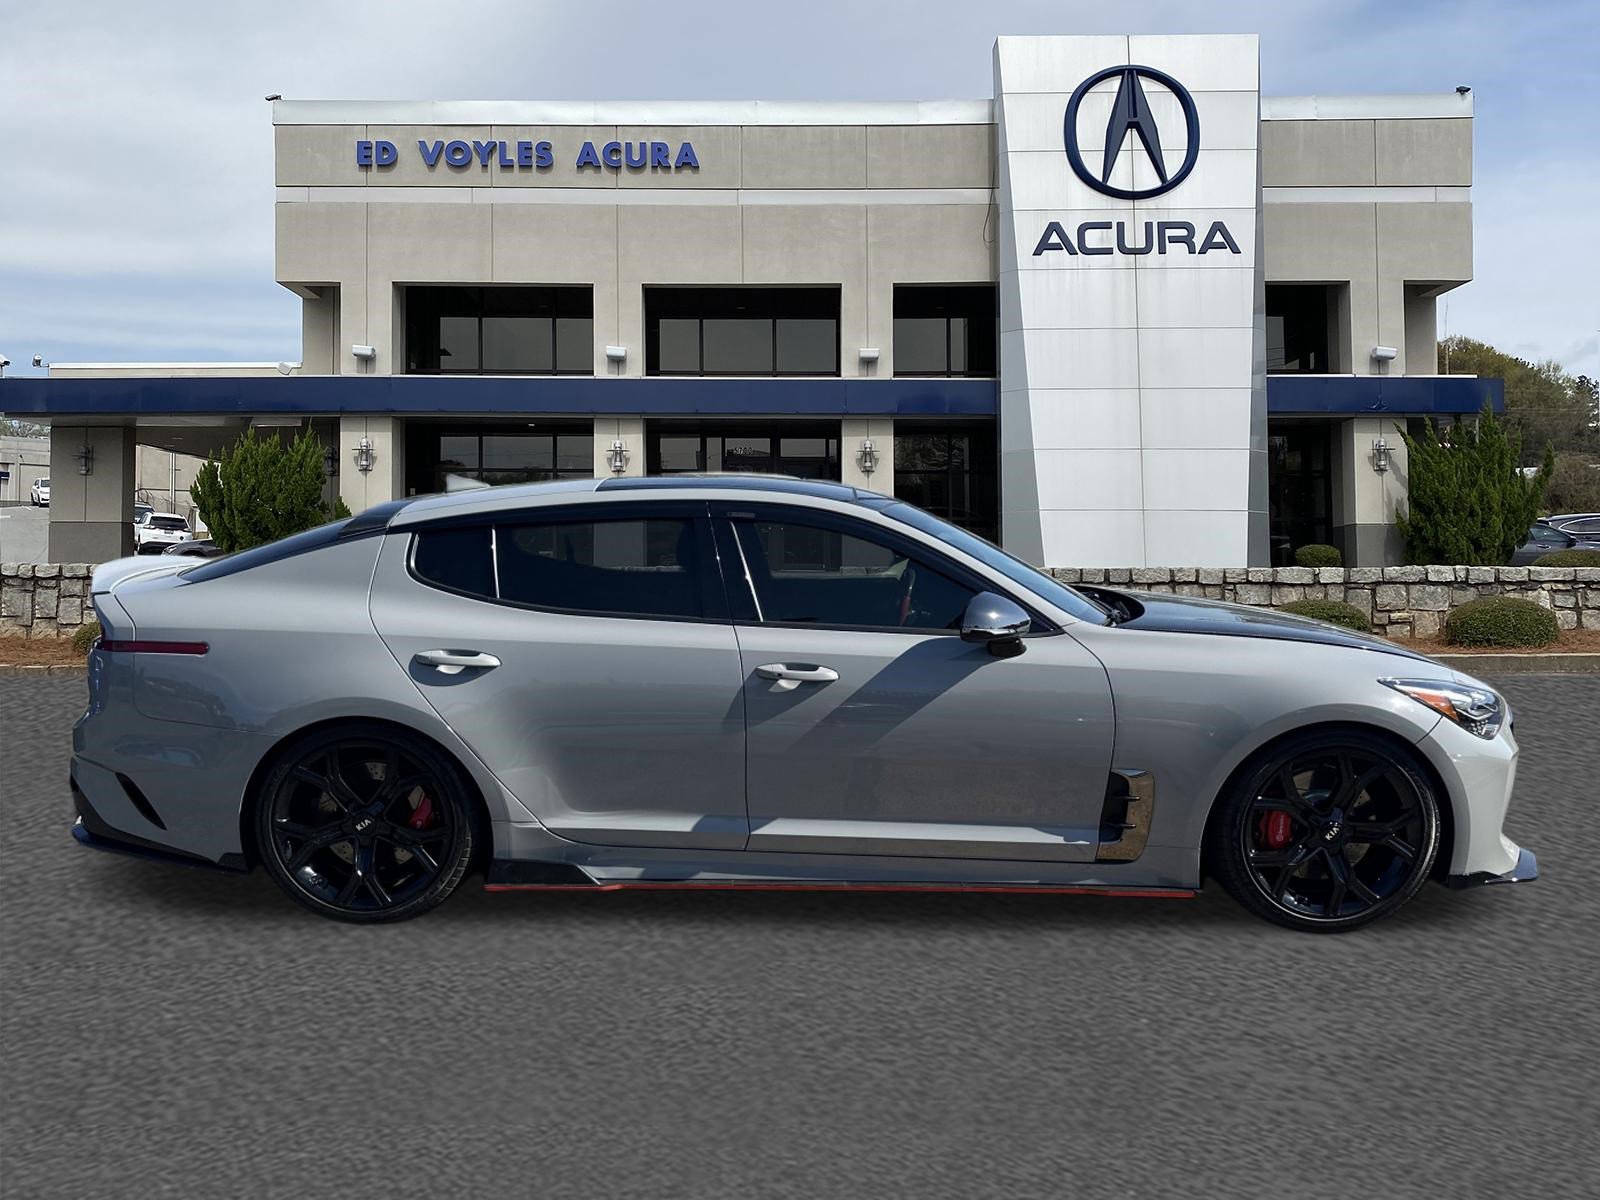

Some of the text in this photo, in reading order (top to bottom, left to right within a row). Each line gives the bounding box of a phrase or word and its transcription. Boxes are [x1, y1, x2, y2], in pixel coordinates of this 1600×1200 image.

[356, 140, 700, 168] ED VOYLES ACURA
[1032, 221, 1242, 256] ACURA
[355, 818, 372, 831] KIA
[1325, 827, 1340, 840] KIA
